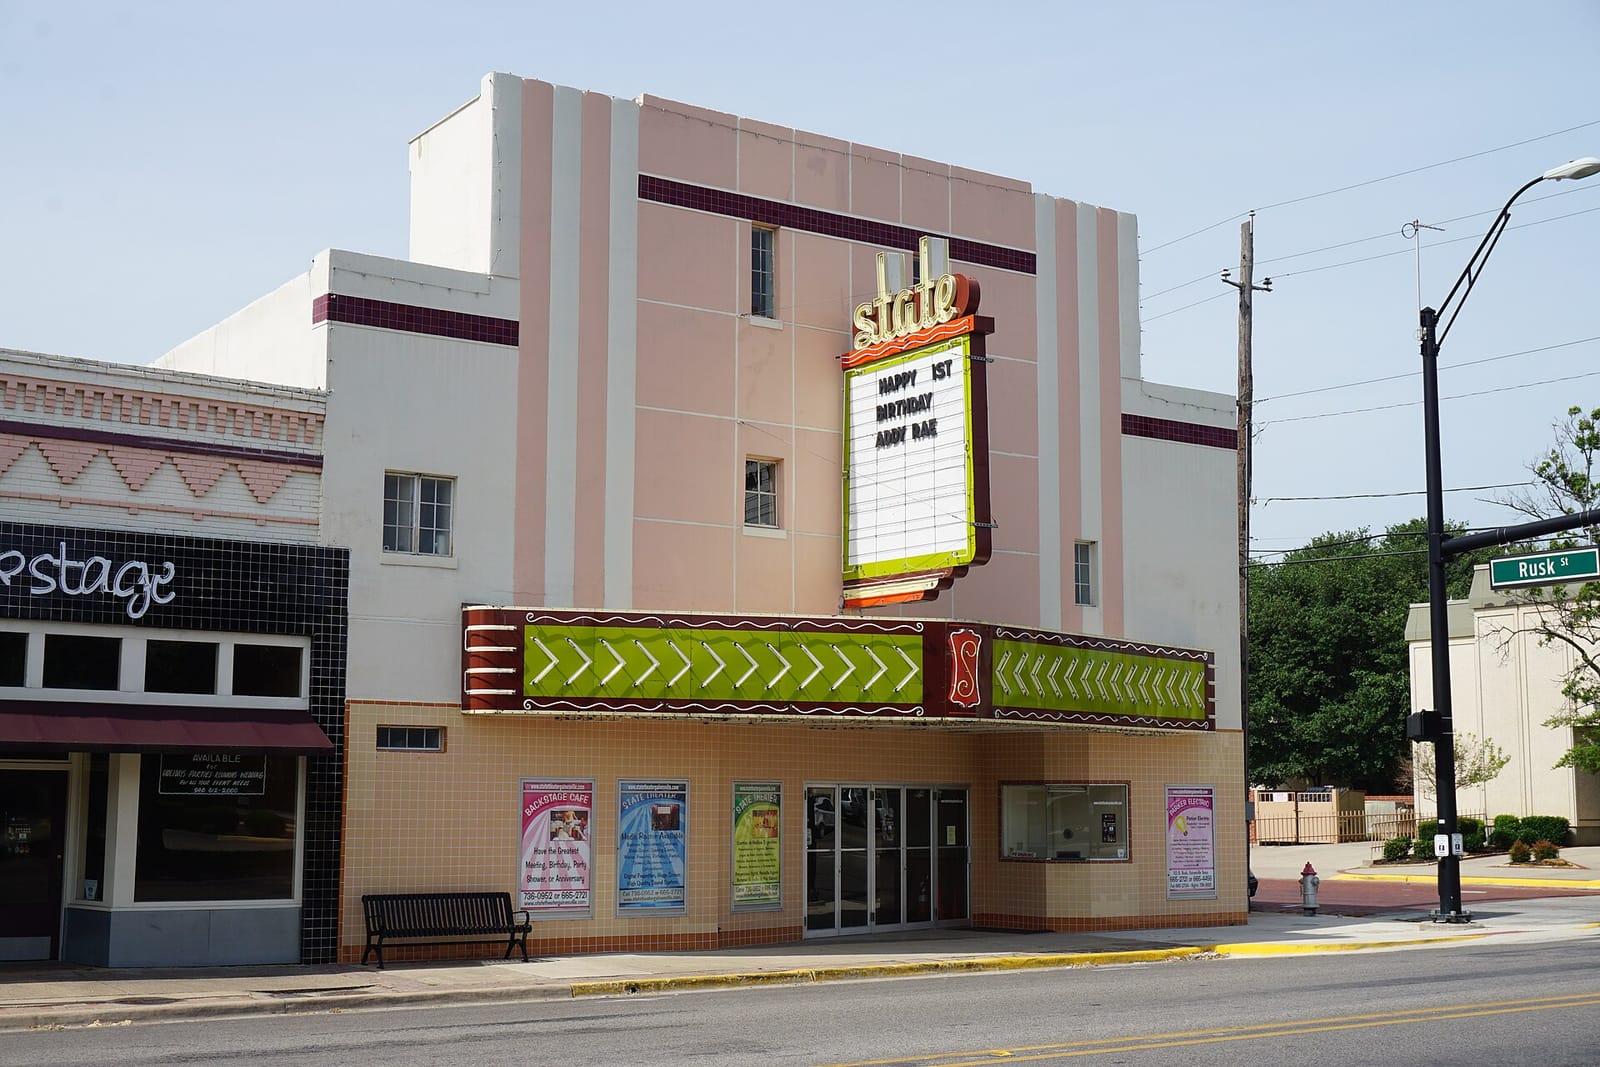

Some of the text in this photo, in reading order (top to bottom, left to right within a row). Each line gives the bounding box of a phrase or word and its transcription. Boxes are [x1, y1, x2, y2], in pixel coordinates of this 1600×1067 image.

[854, 236, 959, 350] state
[879, 369, 917, 396] HAPPY
[876, 392, 933, 422] BIRTHDAY
[875, 418, 938, 448] ADDY RAE
[1519, 557, 1569, 577] Rusk St
[193, 754, 240, 763] AVAILABLE
[524, 793, 589, 817] BACKSTAGE CAFE
[622, 794, 645, 810] STATE
[1169, 800, 1188, 816] PARKER
[1188, 798, 1209, 808] ELECTRIC
[534, 847, 547, 855] Have
[549, 860, 572, 871] Birthday,
[573, 860, 587, 870] Party
[555, 874, 585, 884] Anniversary
[524, 891, 553, 900] 736-0952
[561, 891, 588, 899] 665-2721
